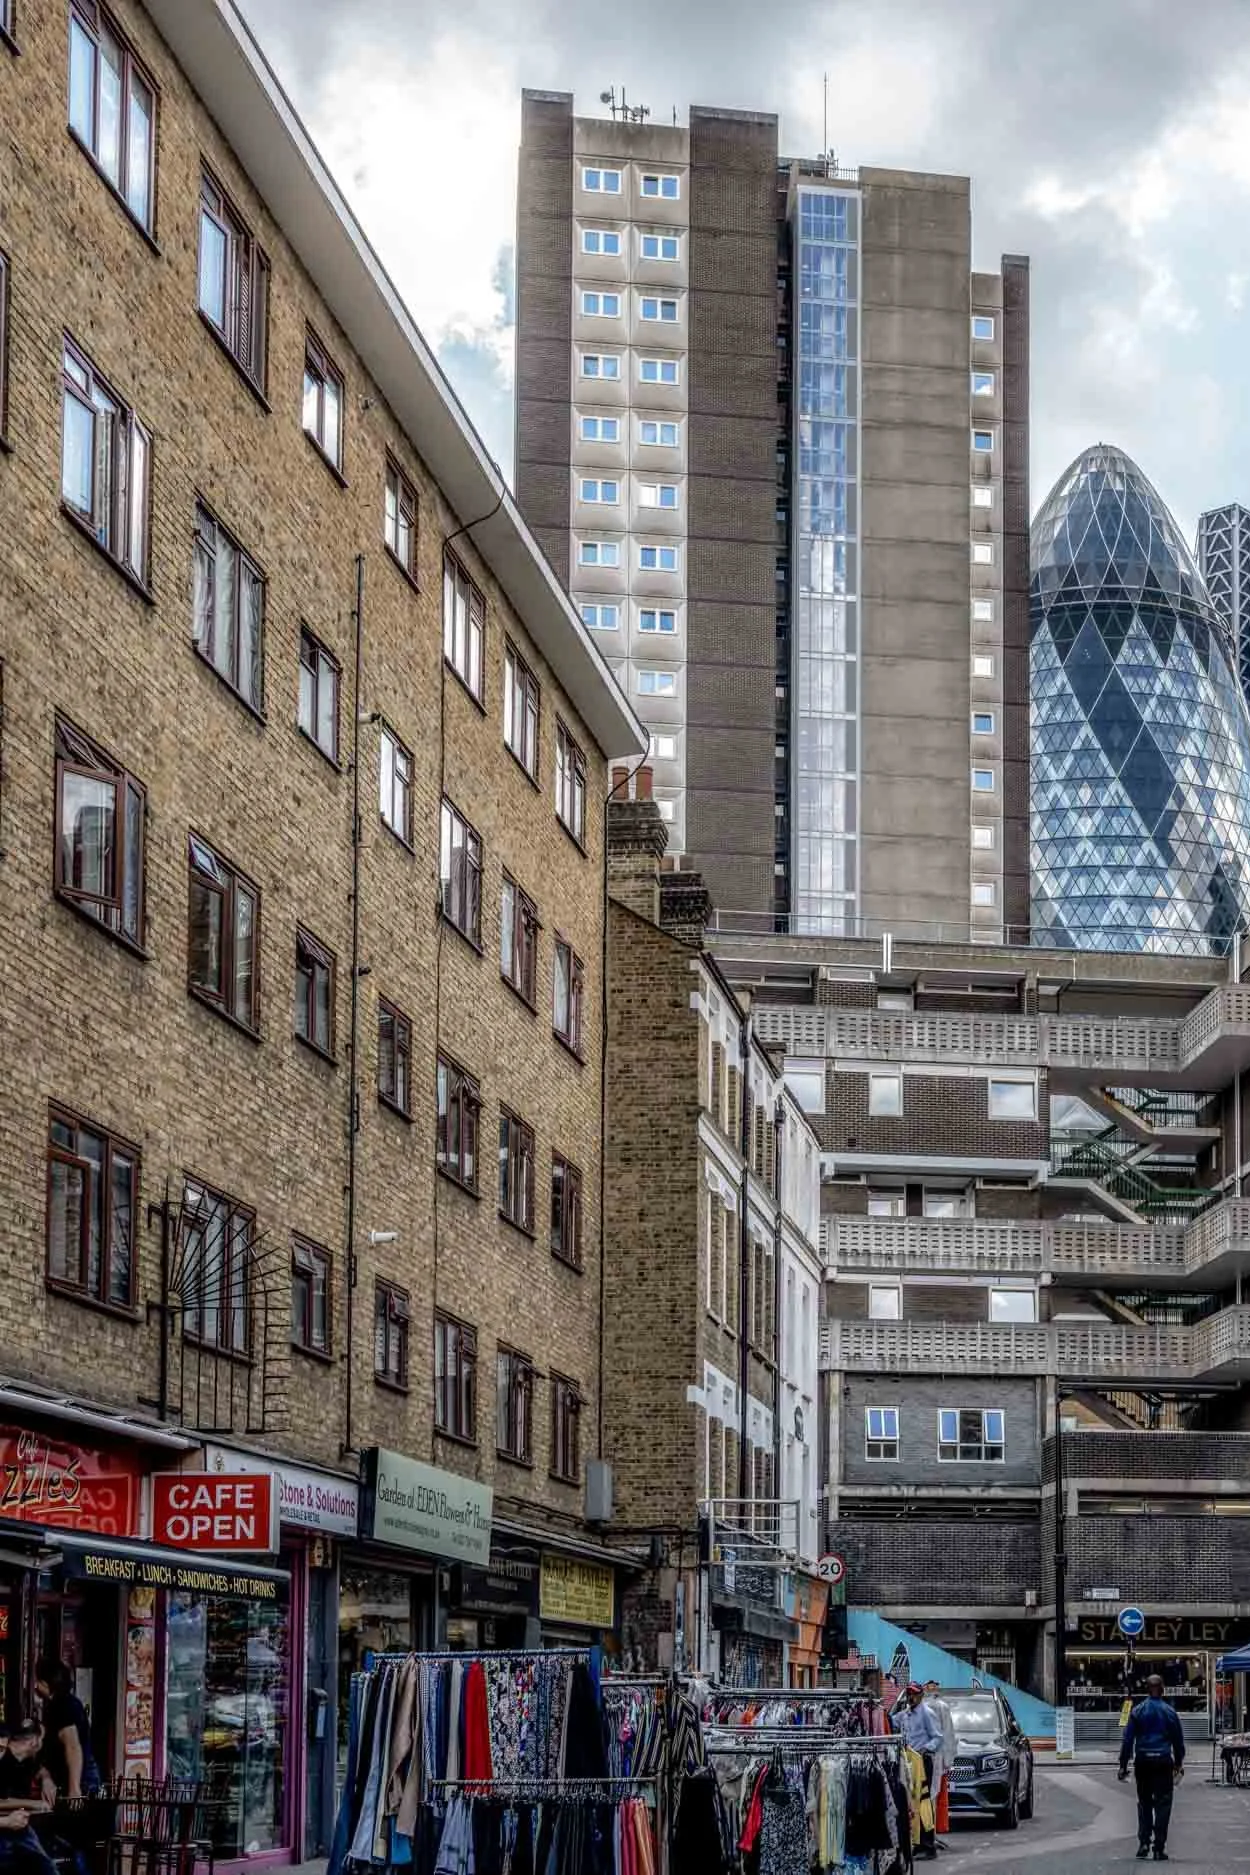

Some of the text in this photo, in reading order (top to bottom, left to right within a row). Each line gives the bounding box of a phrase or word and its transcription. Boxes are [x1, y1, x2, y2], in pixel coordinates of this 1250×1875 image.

[169, 1484, 255, 1511] CAFE
[307, 1484, 313, 1507] &
[316, 1487, 356, 1519] Solutions
[378, 1473, 407, 1507] Garden
[417, 1485, 439, 1515] EDEN
[165, 1515, 256, 1541] OPEN
[85, 1555, 276, 1598] BREAKFAST LUNCH SANDWICHES HOT DRINKS
[820, 1562, 841, 1576] 20
[1081, 1621, 1230, 1641] STALEY LEY
